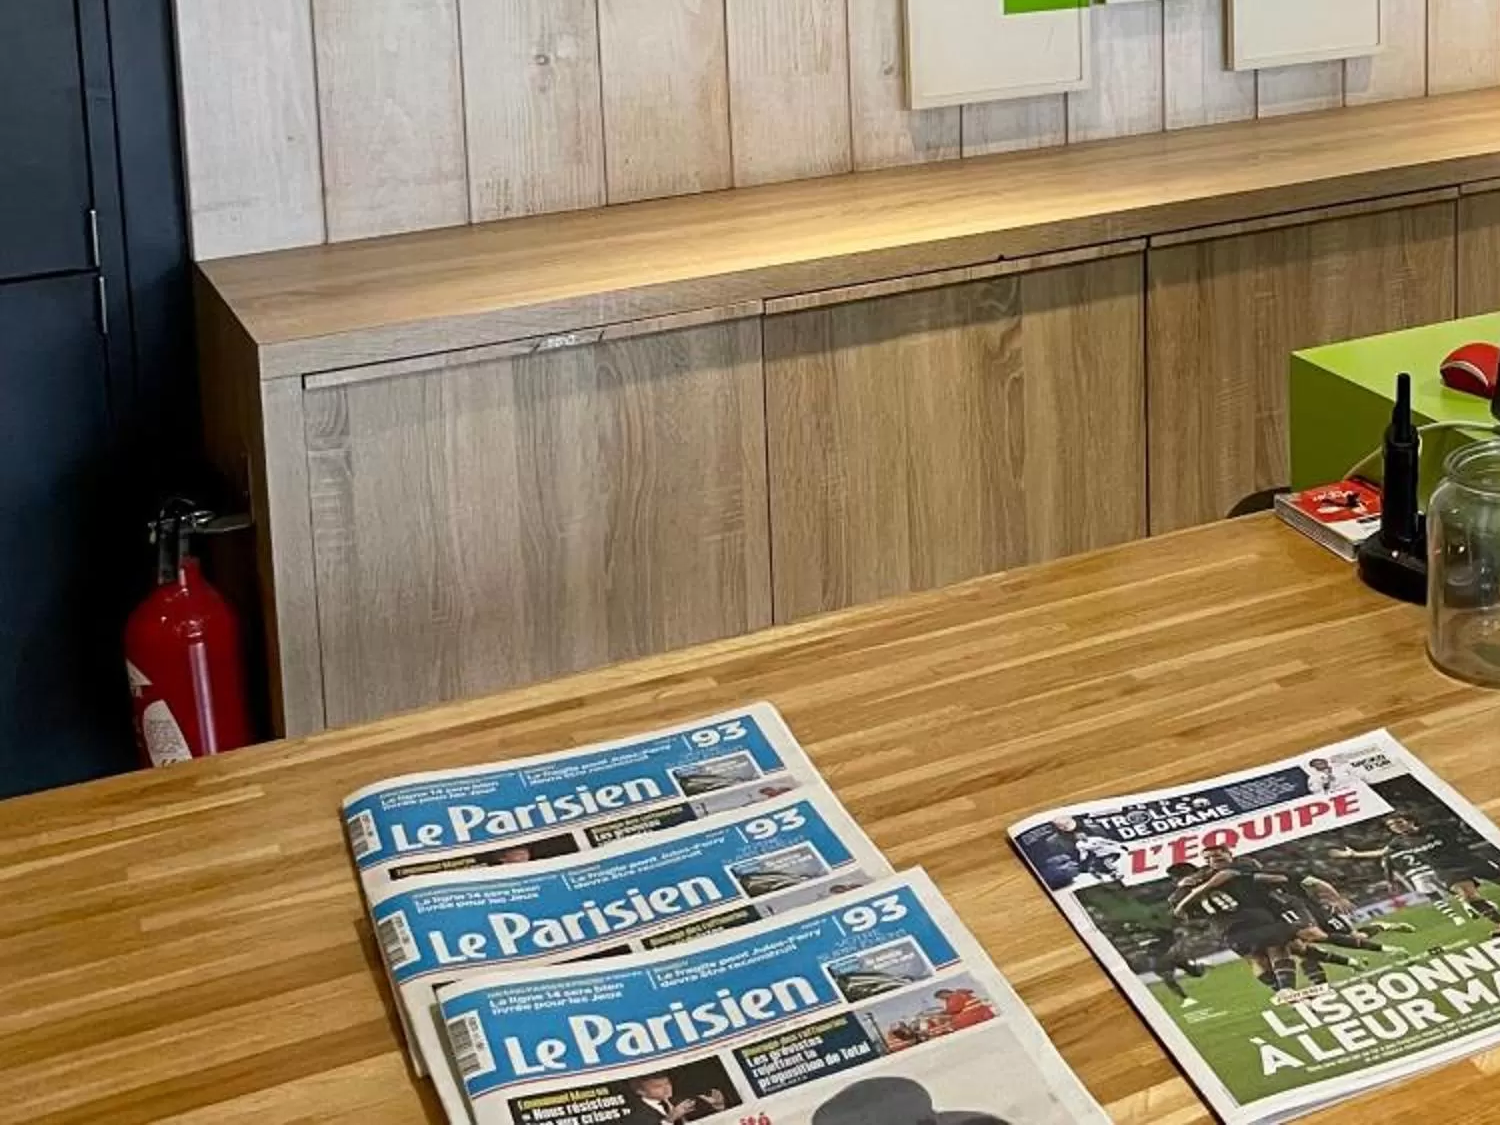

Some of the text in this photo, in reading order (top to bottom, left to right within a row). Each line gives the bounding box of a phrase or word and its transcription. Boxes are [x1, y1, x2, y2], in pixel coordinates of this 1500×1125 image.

[691, 721, 749, 748] 93
[391, 823, 443, 852] Le
[447, 777, 662, 843] Parisien
[745, 809, 806, 840] 93
[1118, 804, 1234, 841] DE DRAME
[430, 931, 487, 964] Le
[488, 877, 722, 955] Parisien
[843, 894, 907, 932] 93
[504, 976, 819, 1076] Le Parisien
[1249, 1037, 1305, 1077] À
[1300, 1001, 1450, 1063] LEUR
[757, 1041, 871, 1089] proposition de Total
